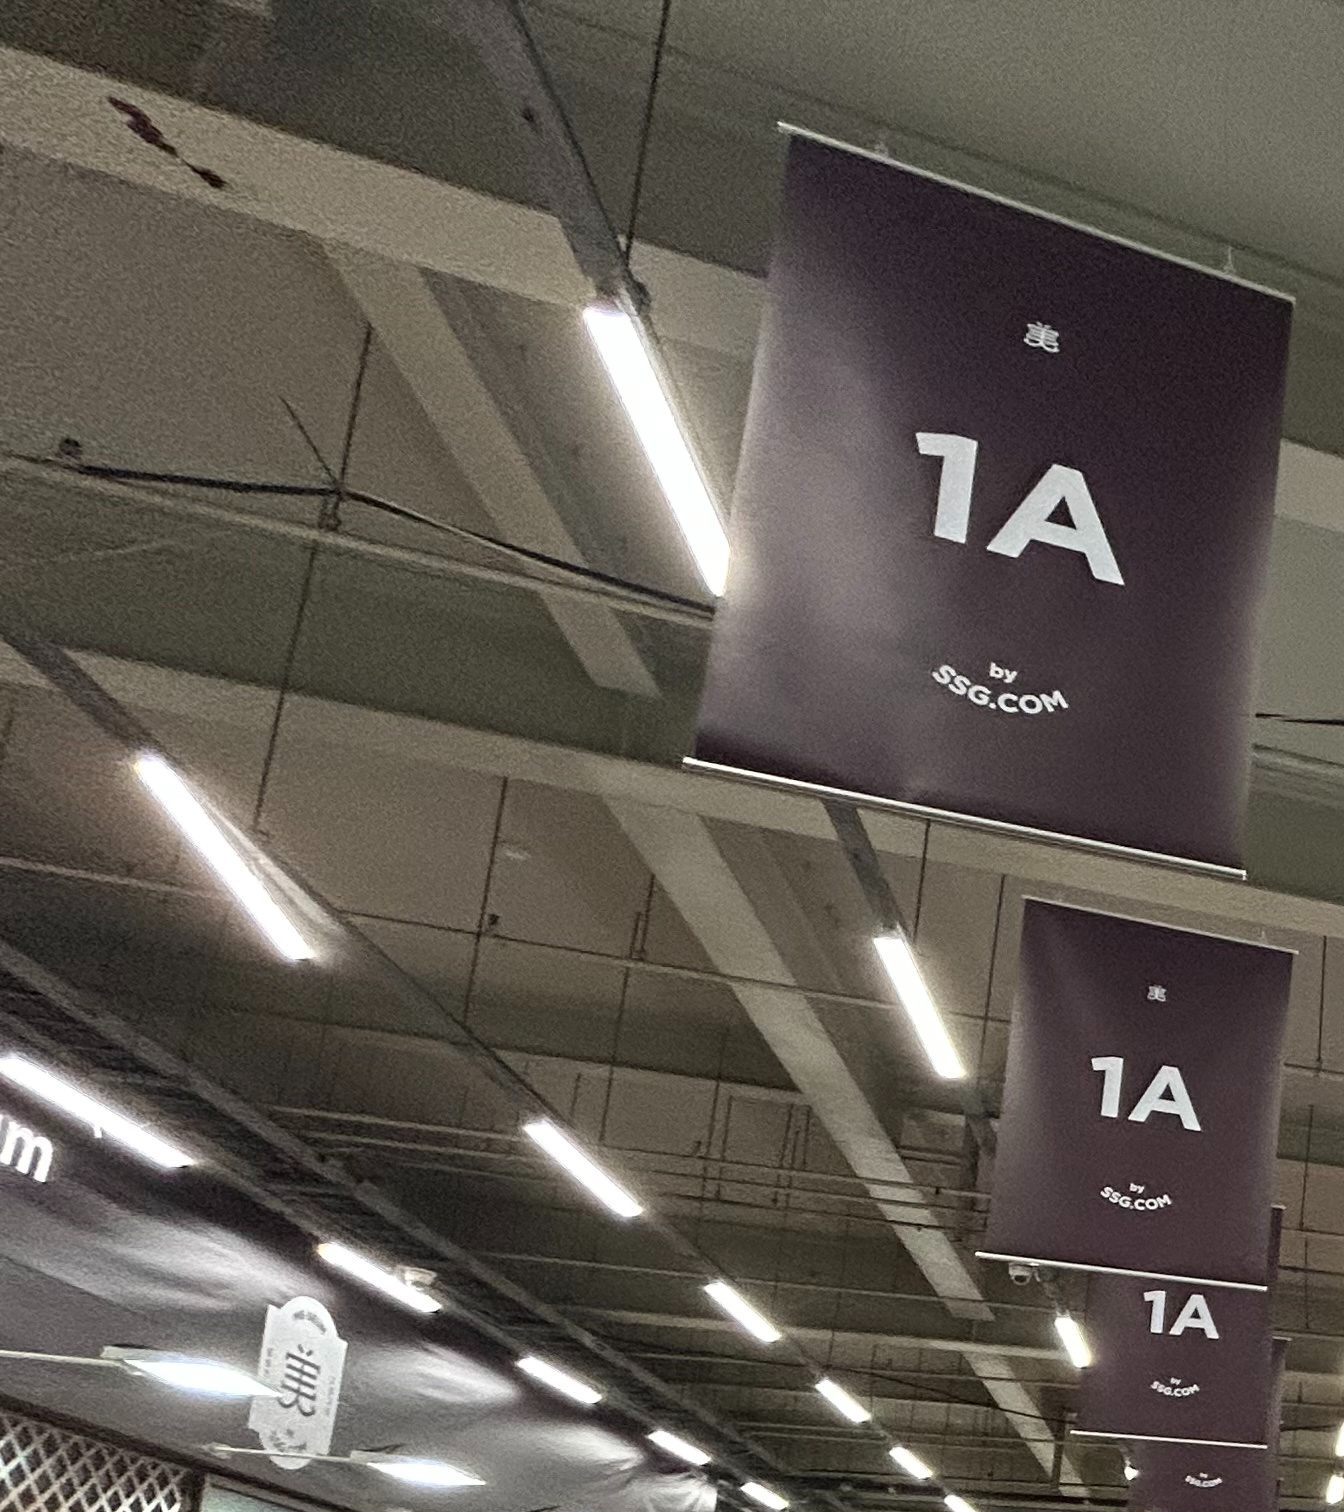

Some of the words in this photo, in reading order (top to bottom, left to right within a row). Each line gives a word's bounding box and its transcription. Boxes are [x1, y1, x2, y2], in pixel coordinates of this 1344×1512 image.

[915, 432, 1125, 586] 1A
[931, 664, 1069, 715] SSG.COM
[989, 661, 1018, 684] by
[1091, 1056, 1201, 1132] 1A
[1100, 1186, 1172, 1211] SSG.COM
[1129, 1182, 1145, 1194] by
[1143, 1290, 1220, 1339] 1A
